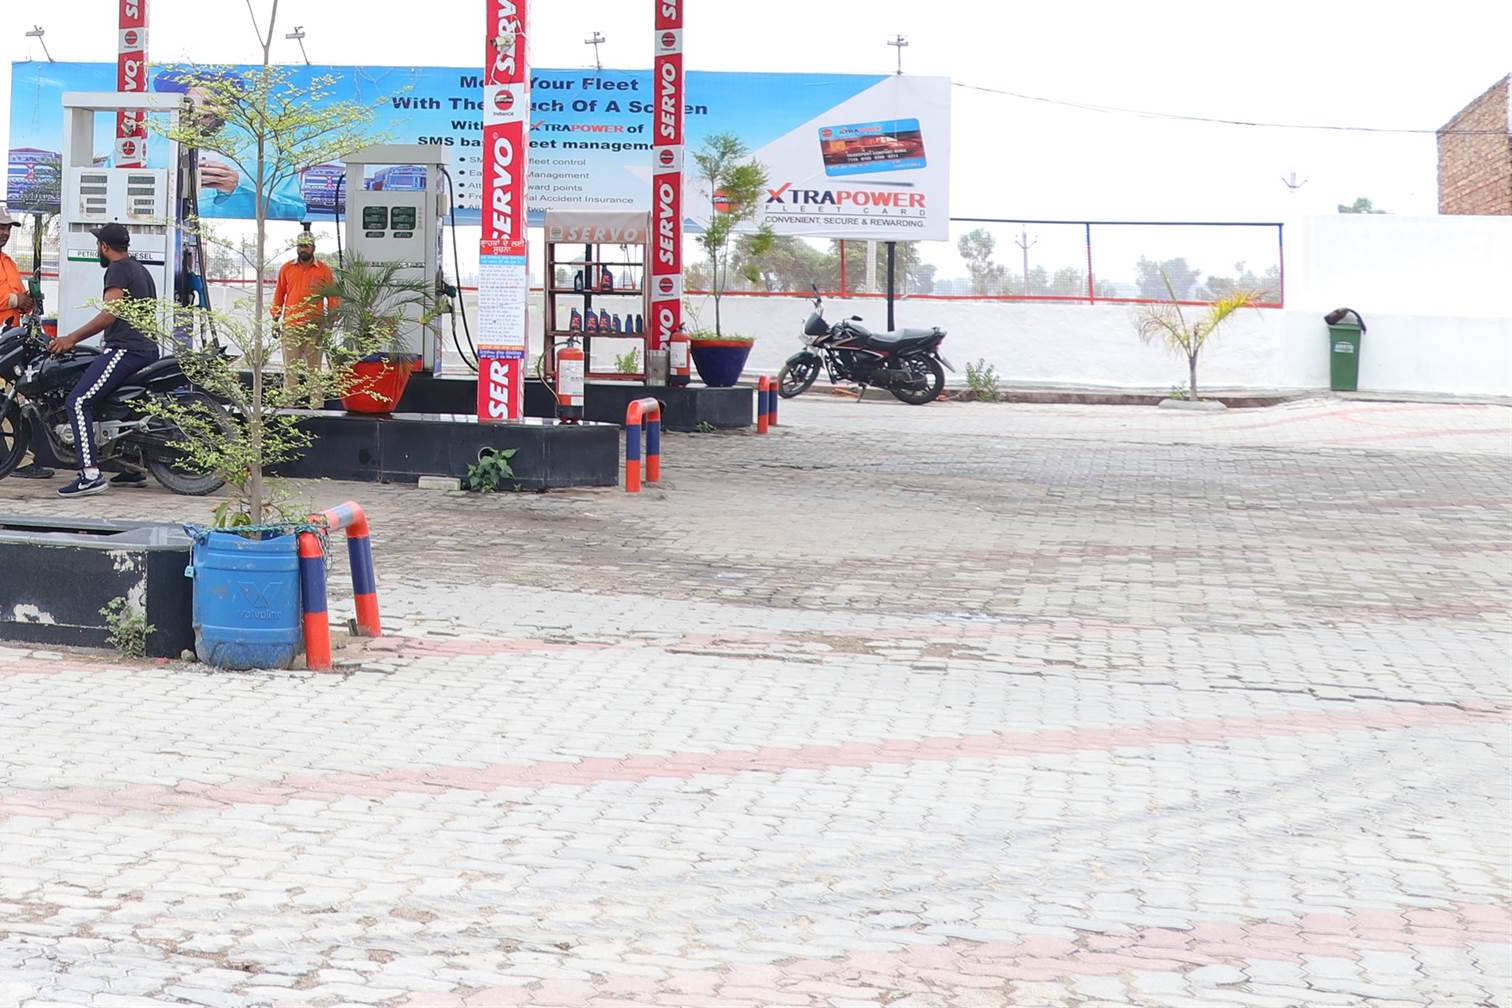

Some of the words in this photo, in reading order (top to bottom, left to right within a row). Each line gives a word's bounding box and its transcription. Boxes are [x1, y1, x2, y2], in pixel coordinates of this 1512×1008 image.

[582, 78, 639, 91] Fleet
[392, 96, 441, 110] With
[448, 97, 484, 110] The
[572, 100, 598, 113] Of
[605, 101, 621, 113] A
[628, 101, 708, 115] Scen
[661, 62, 677, 139] SERVO
[627, 124, 645, 134] of
[418, 136, 455, 146] SMS
[553, 158, 586, 166] control
[553, 185, 583, 193] points
[766, 182, 926, 208] XTRAPOWER
[585, 196, 634, 204] Insurance
[863, 208, 926, 216] CARD
[659, 183, 674, 266] SERVO
[568, 226, 639, 241] SERVO
[488, 361, 510, 420] SER
